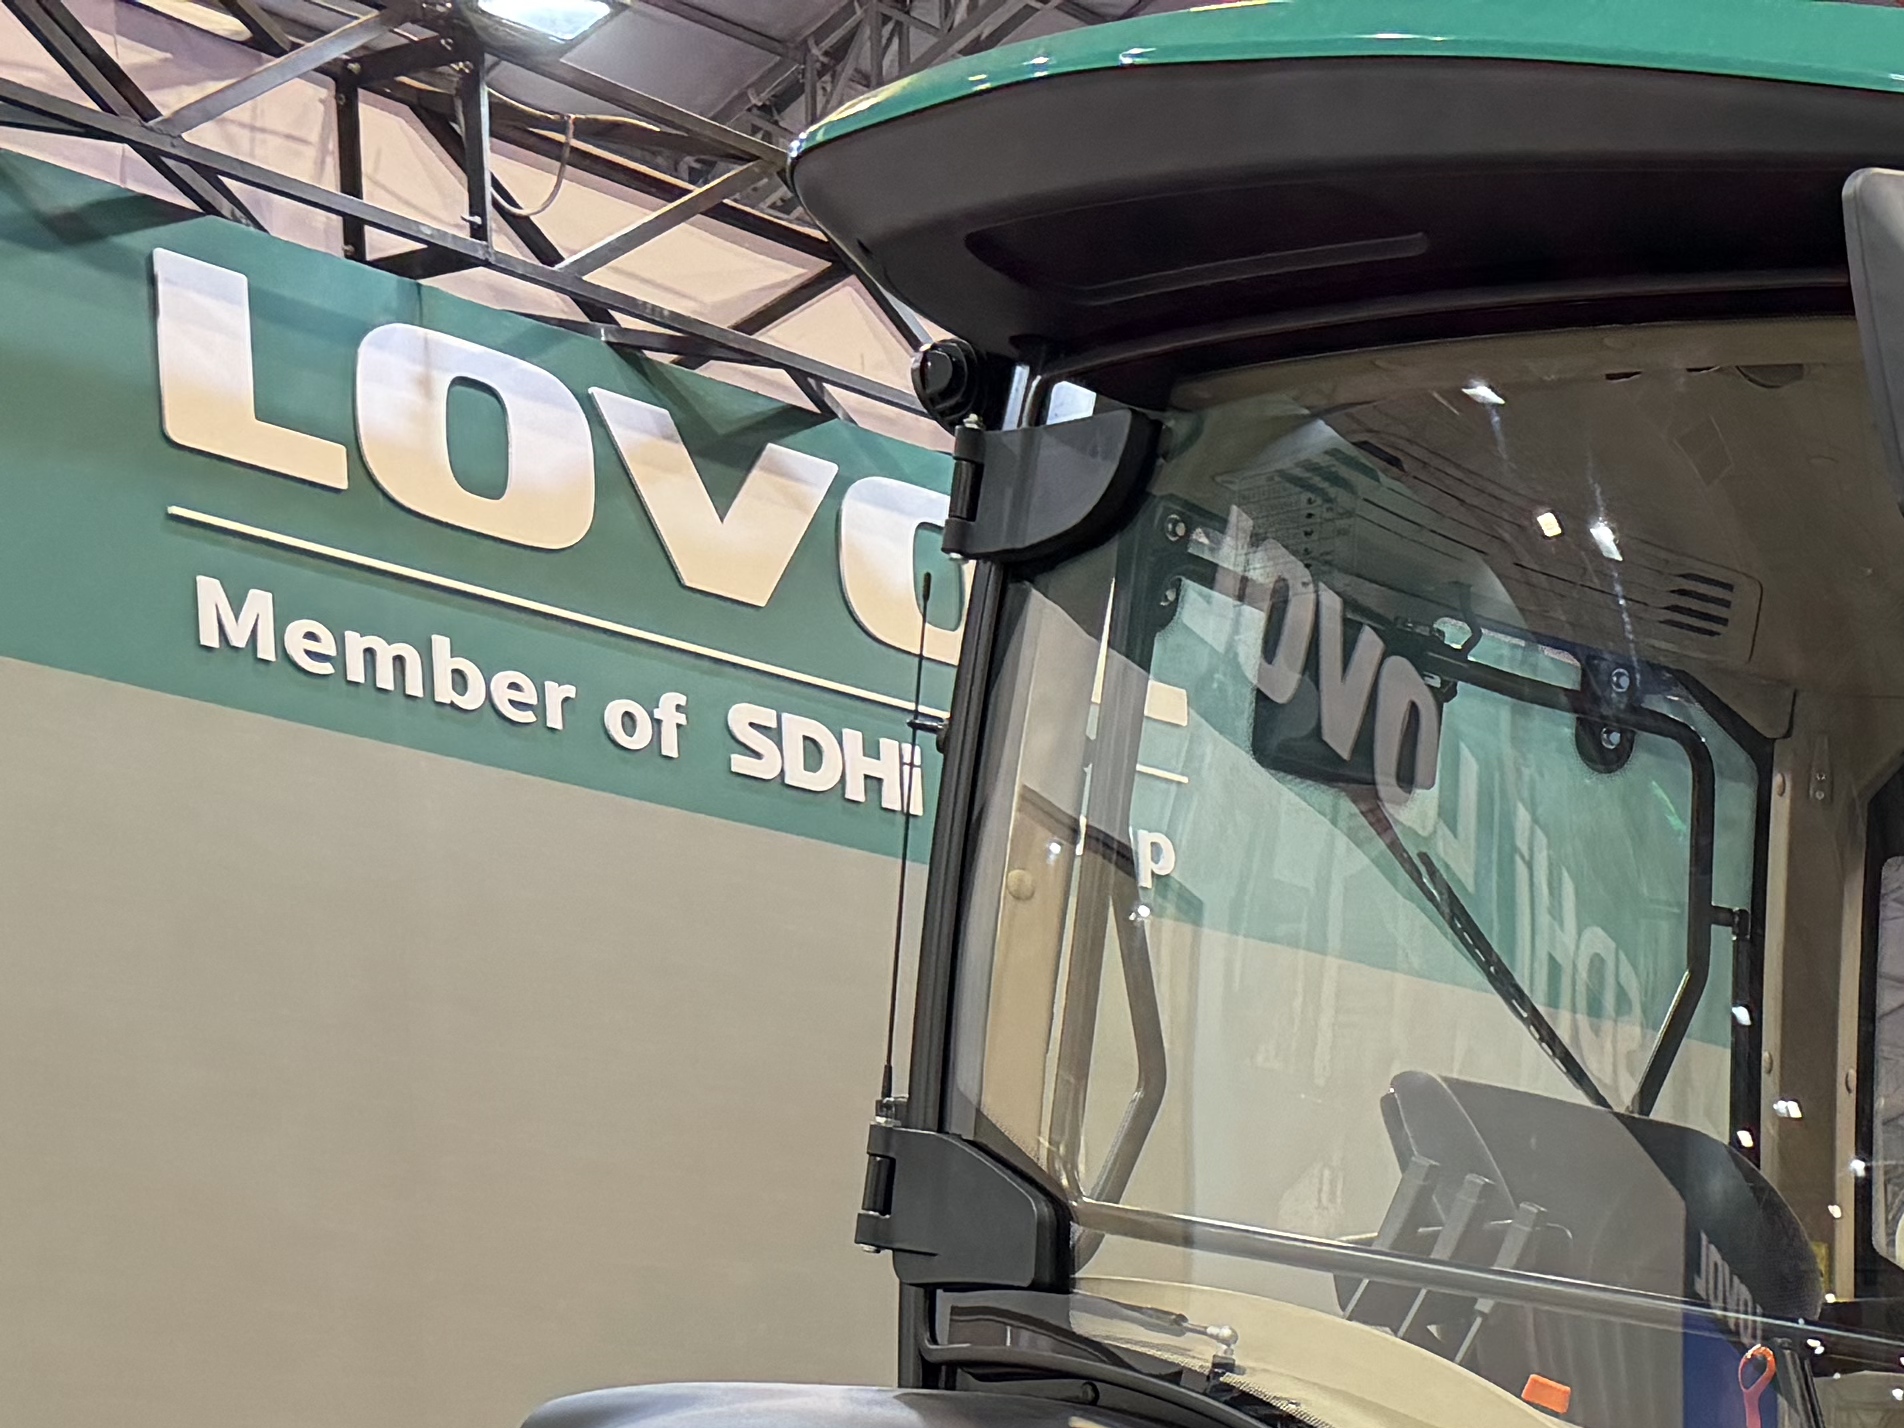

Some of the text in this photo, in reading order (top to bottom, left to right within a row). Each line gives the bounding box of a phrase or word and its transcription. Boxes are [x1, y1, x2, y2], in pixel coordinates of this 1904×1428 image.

[152, 247, 970, 666] LOVO
[196, 573, 577, 732] Member
[604, 691, 689, 760] of
